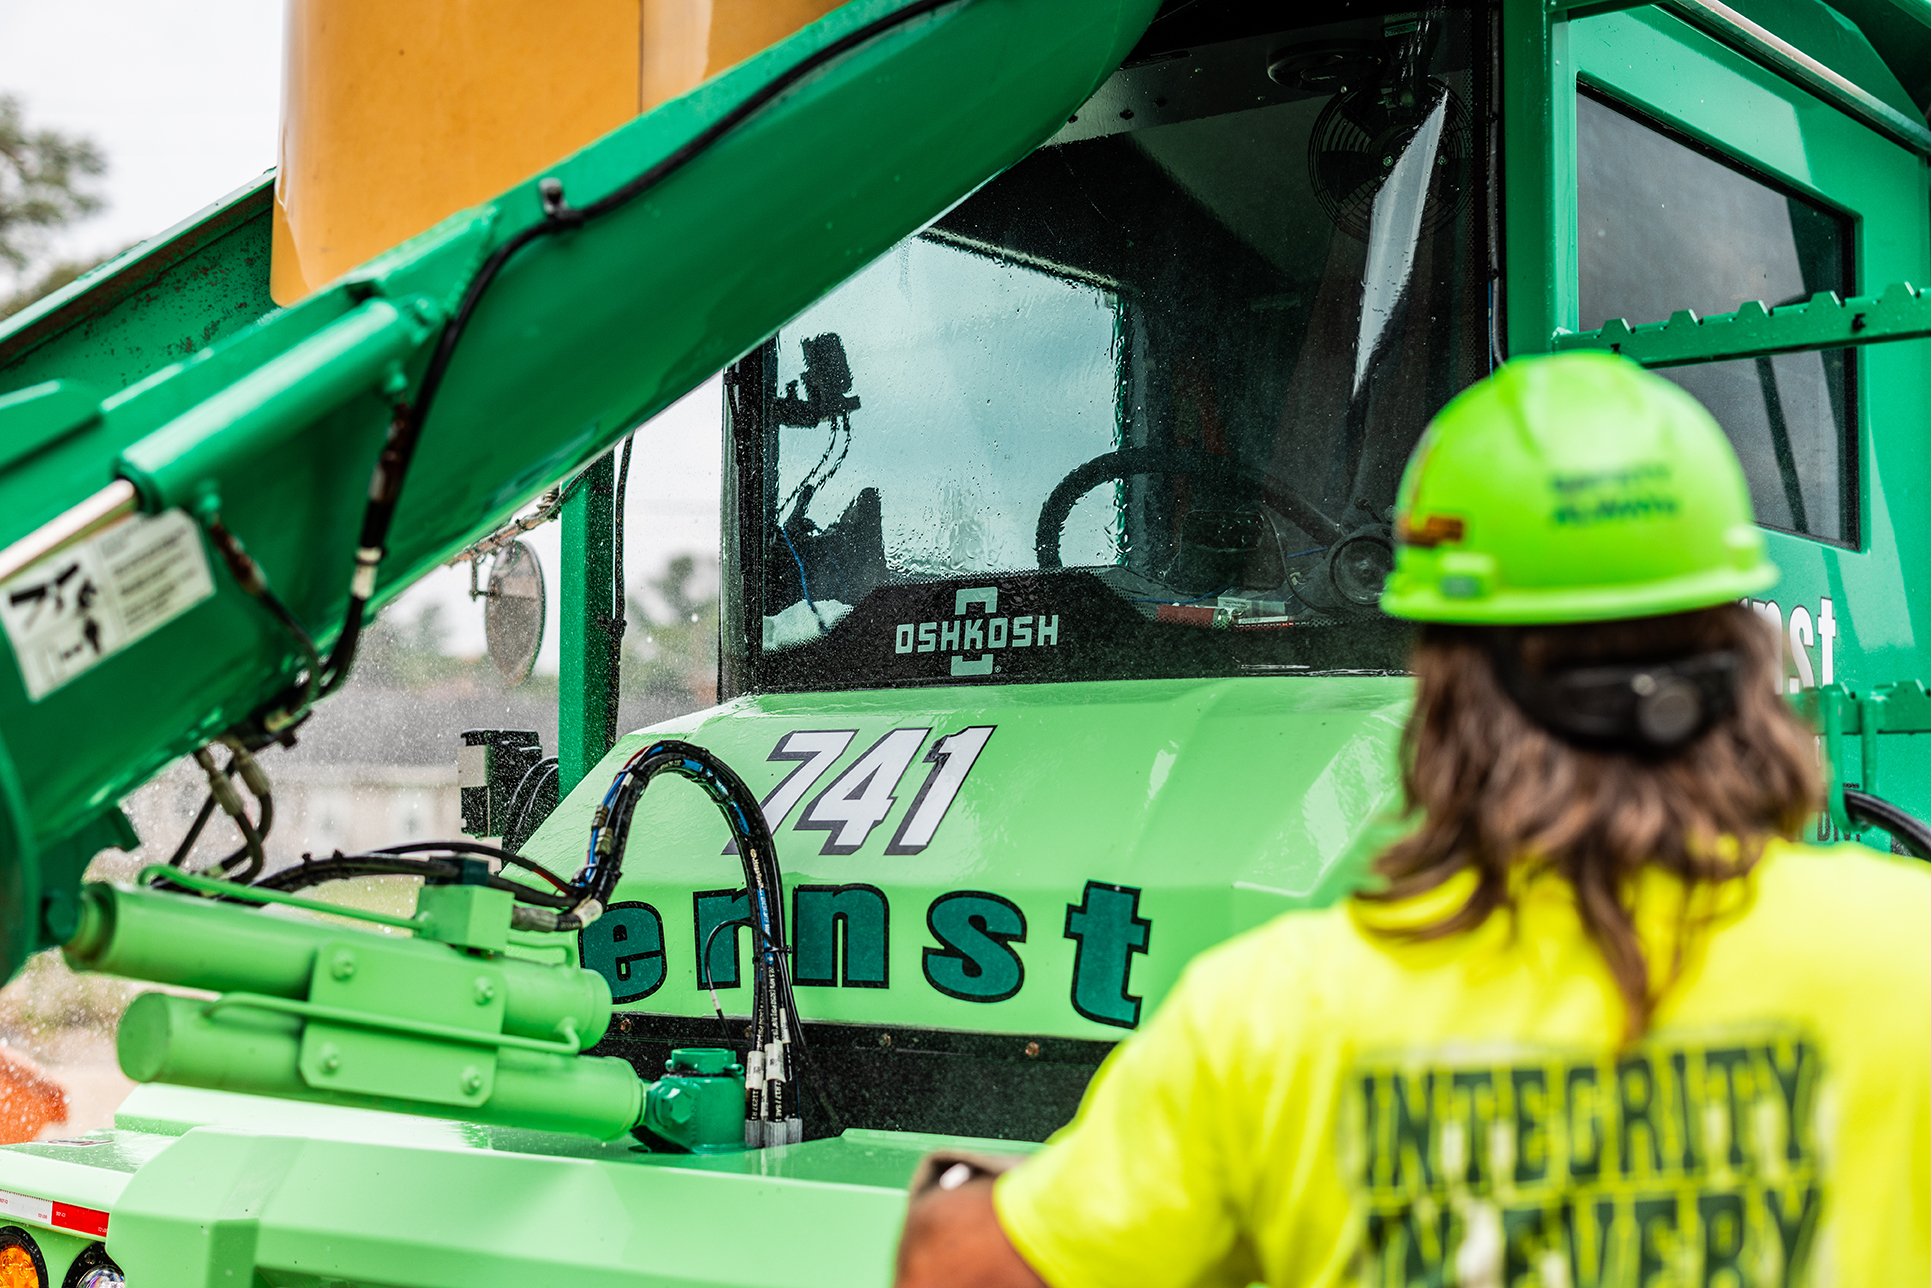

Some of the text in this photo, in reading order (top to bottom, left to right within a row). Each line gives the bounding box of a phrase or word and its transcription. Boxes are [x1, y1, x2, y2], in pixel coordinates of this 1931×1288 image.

[895, 614, 1059, 654] OSHKOSH
[722, 725, 998, 856] 741
[578, 879, 1153, 1030] ernst
[1361, 1043, 1814, 1188] INTEGRITY
[1505, 1188, 1822, 1288] EVERY
